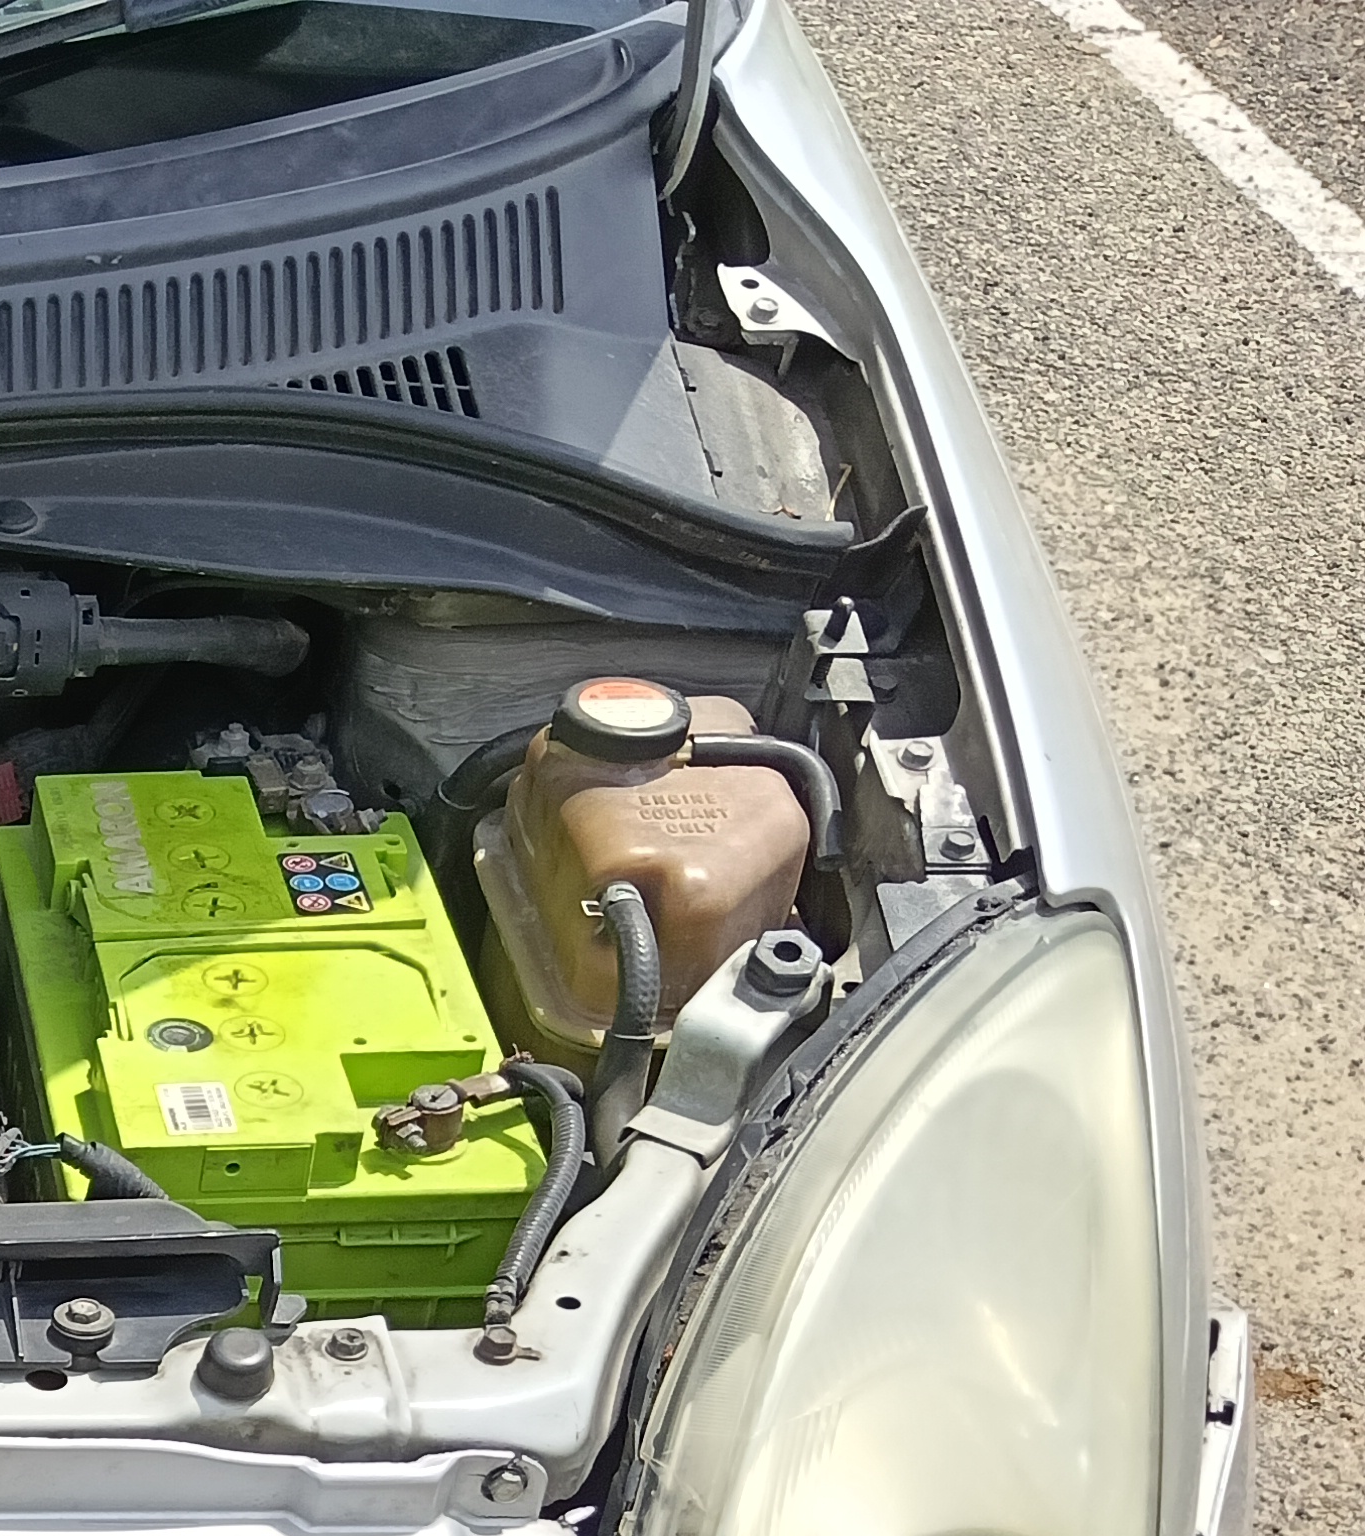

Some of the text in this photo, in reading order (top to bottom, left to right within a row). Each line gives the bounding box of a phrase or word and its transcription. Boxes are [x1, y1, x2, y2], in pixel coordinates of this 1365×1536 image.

[638, 793, 718, 806] ENGINE
[638, 808, 728, 820] COOLANT
[665, 822, 716, 834] ONLY
[90, 781, 155, 894] AMARON
